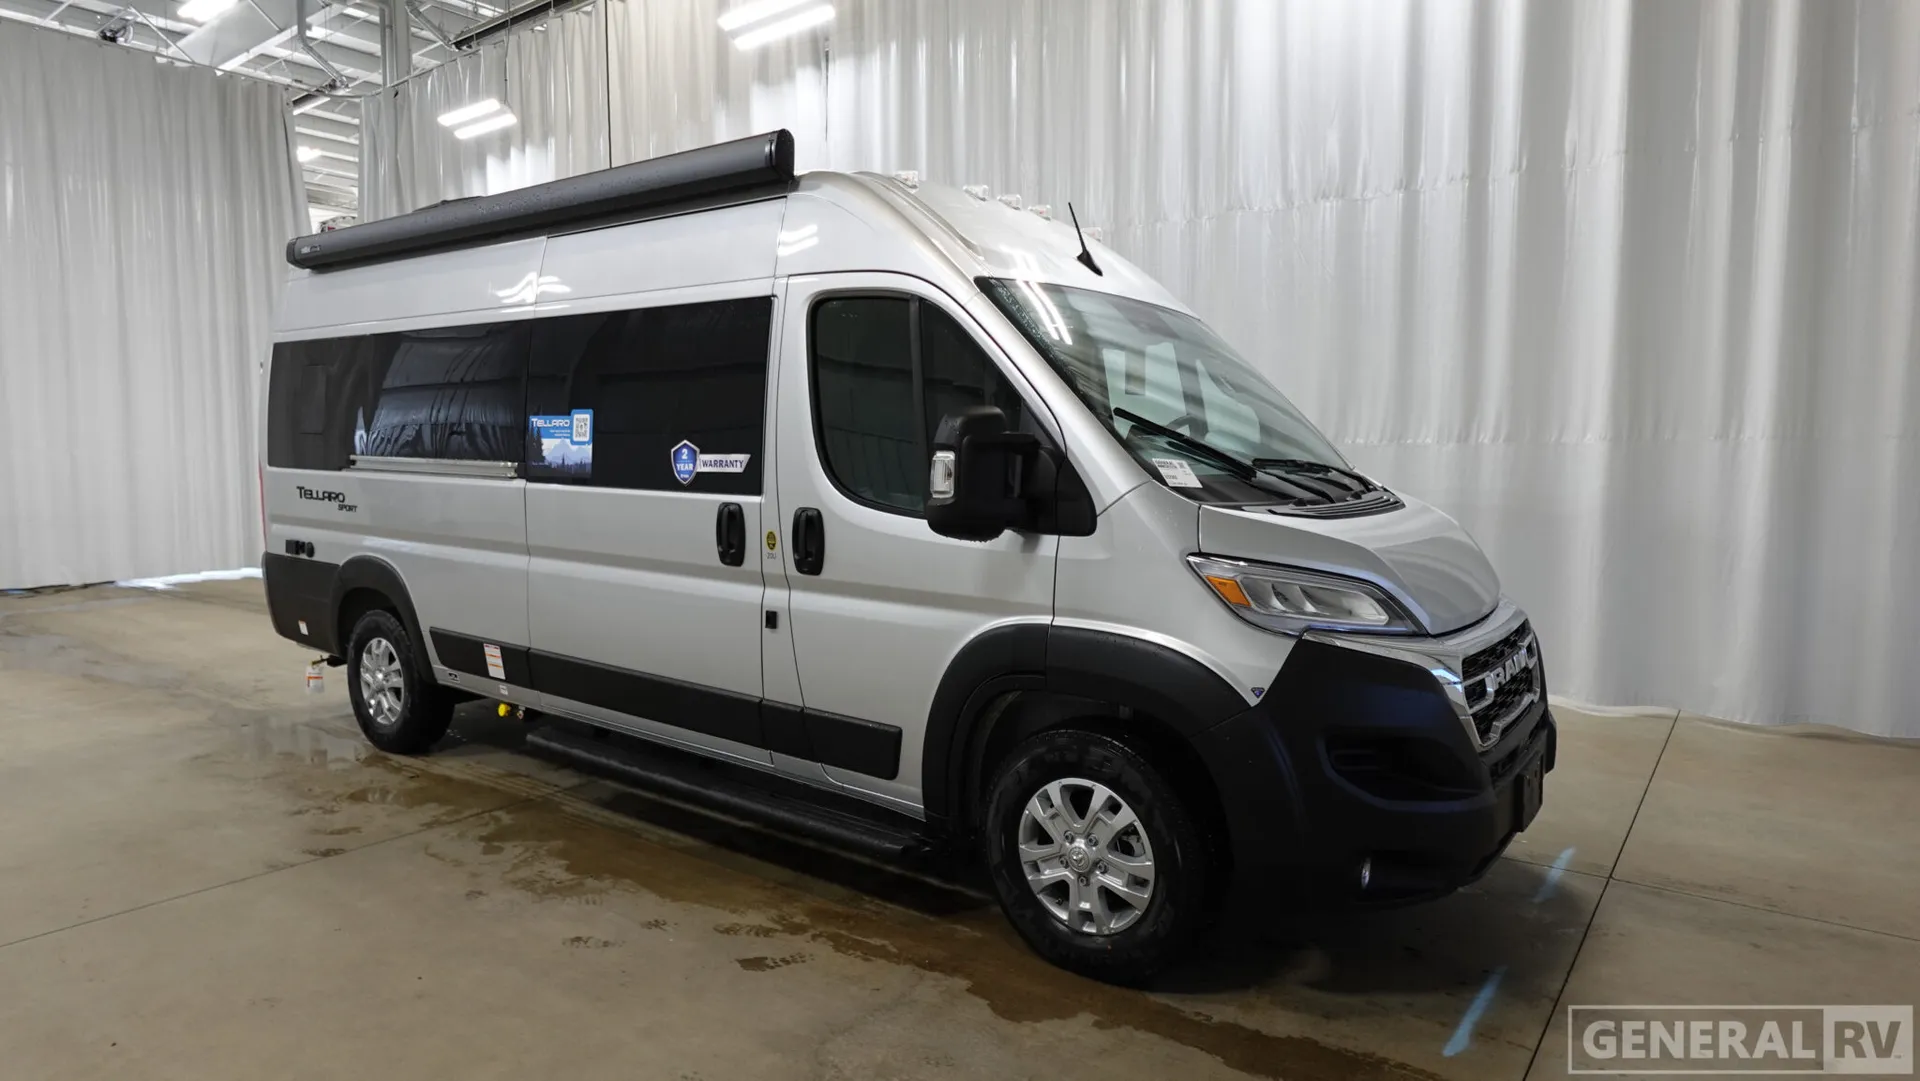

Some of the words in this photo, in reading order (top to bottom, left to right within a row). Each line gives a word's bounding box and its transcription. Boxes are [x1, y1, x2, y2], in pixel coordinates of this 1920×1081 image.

[531, 418, 570, 427] TELLARO
[681, 449, 688, 459] 2
[676, 463, 694, 471] YEAR
[702, 460, 744, 468] WARRANTY
[296, 486, 346, 503] TELLARO
[337, 504, 358, 512] SPORT
[1490, 647, 1528, 692] RAM
